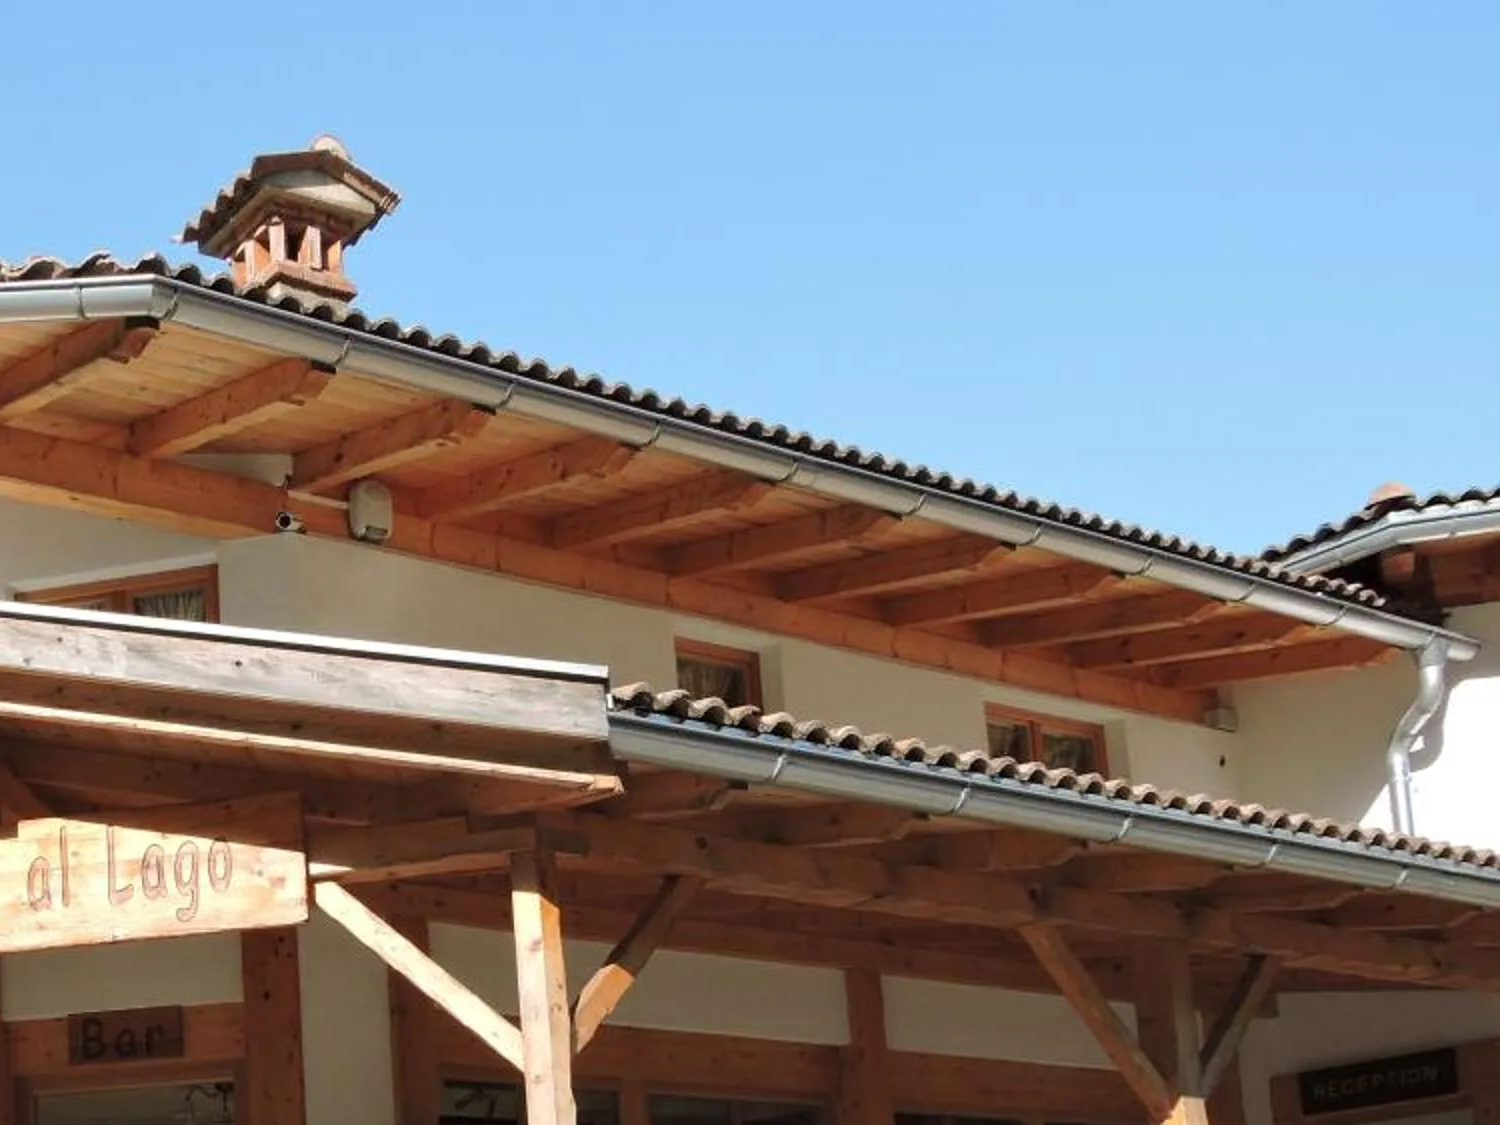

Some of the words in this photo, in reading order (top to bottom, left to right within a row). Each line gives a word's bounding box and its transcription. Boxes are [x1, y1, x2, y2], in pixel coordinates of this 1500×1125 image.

[27, 826, 71, 910] al
[106, 825, 234, 923] Lago
[80, 1016, 167, 1060] Bar
[1312, 1065, 1439, 1098] RECEPTION
